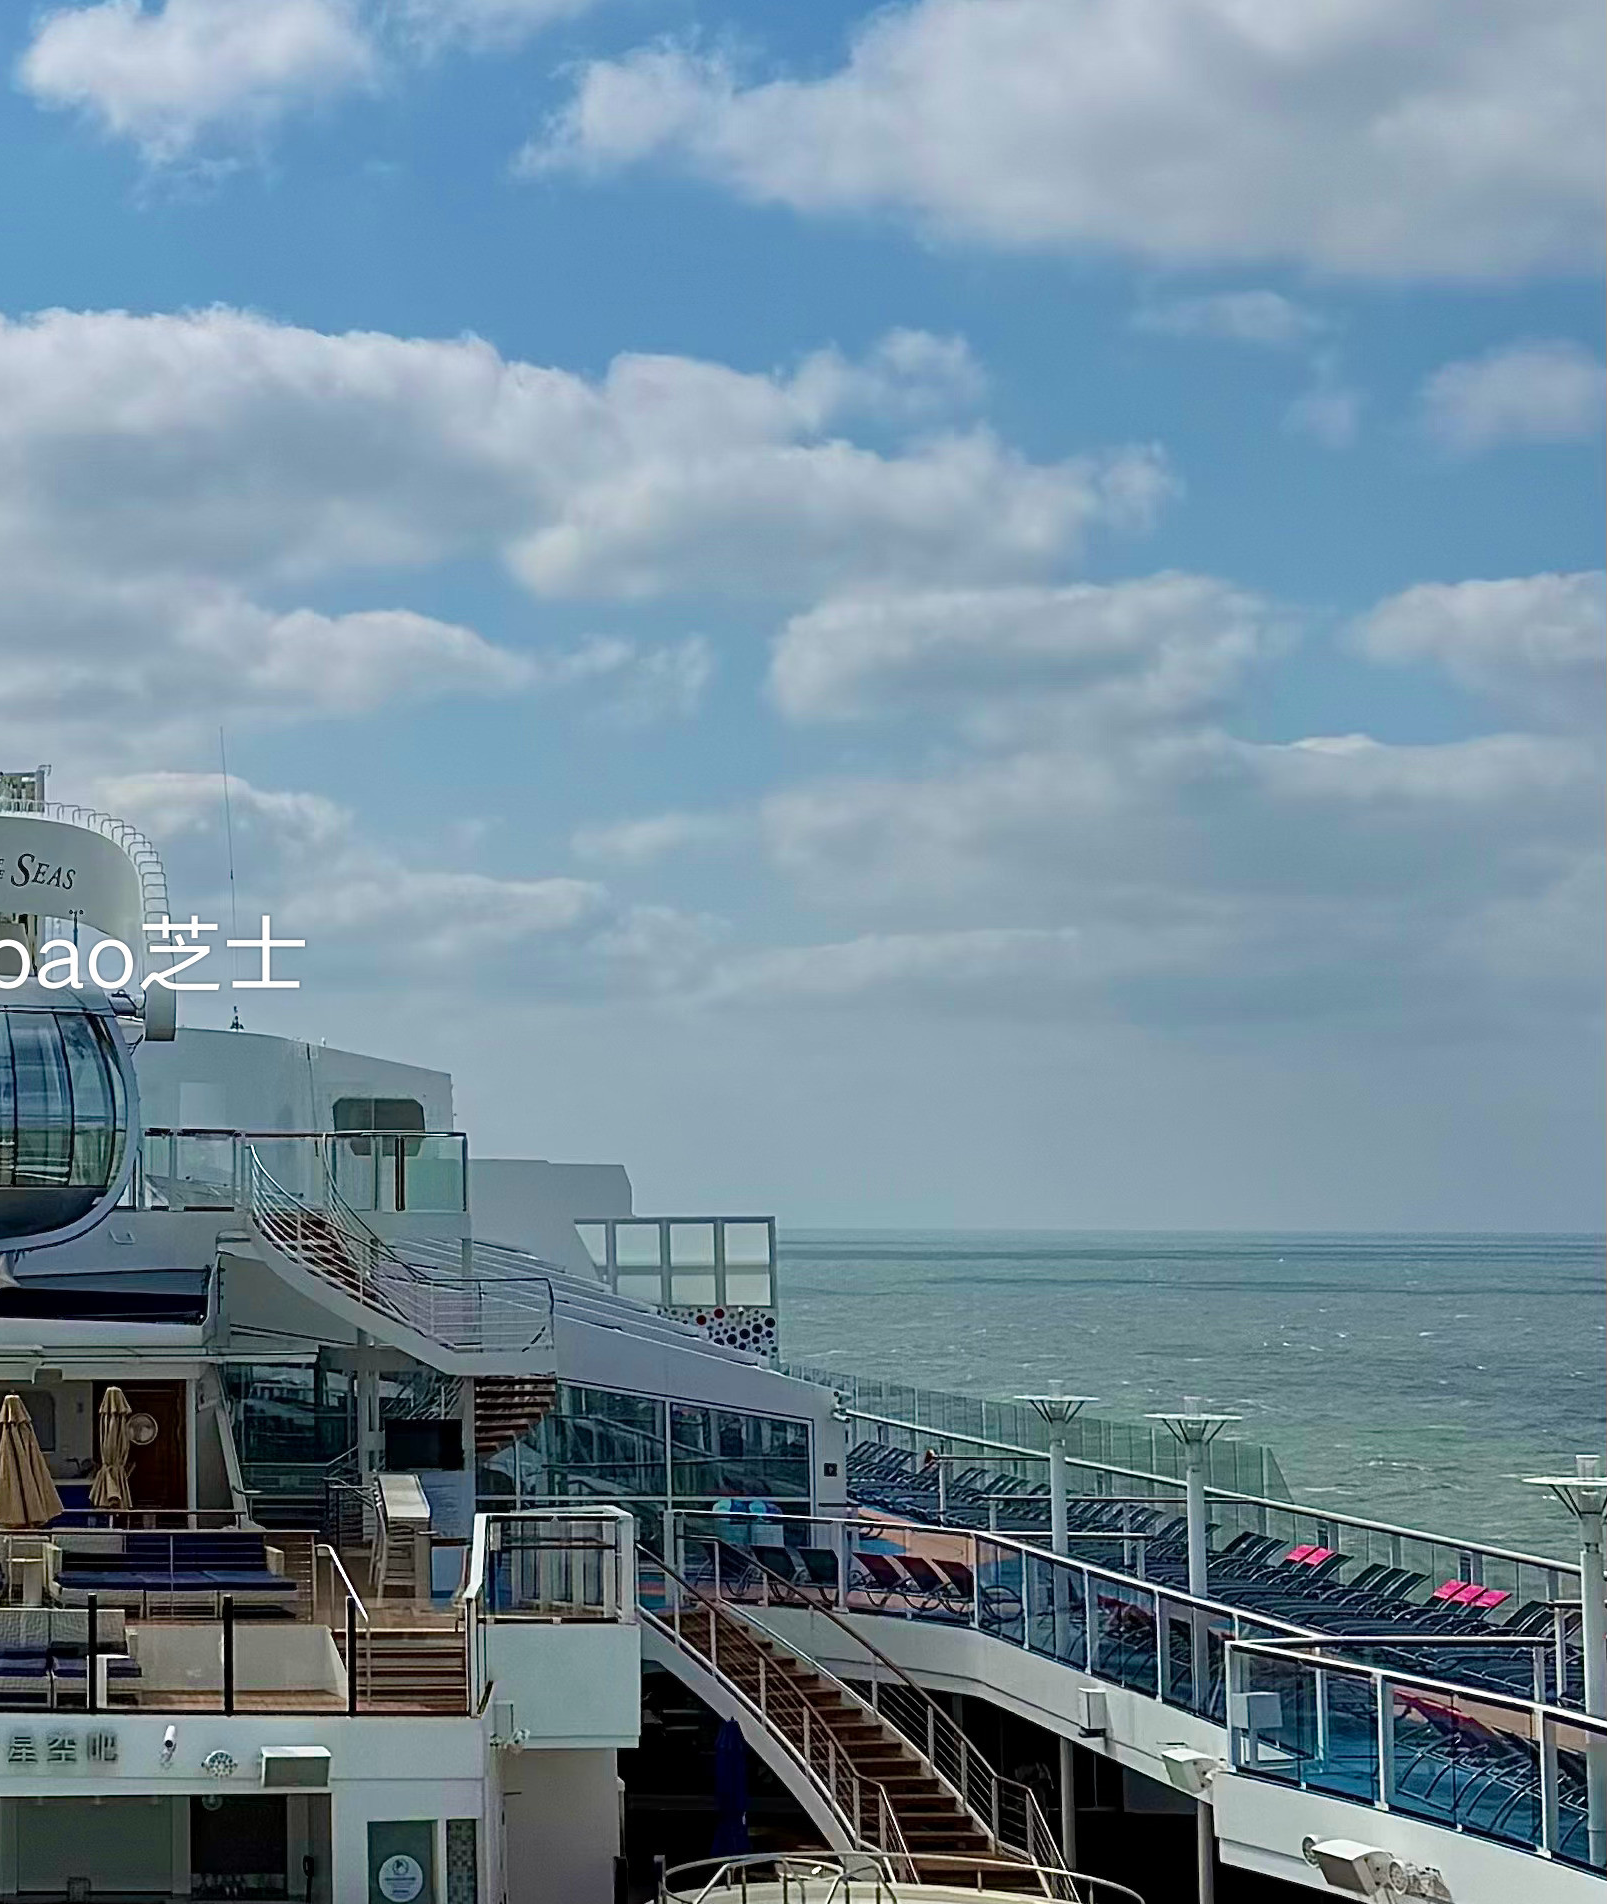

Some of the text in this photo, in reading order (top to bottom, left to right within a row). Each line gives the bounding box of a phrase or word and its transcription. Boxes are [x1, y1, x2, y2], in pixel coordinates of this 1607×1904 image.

[11, 853, 76, 890] SEAS
[8, 1730, 119, 1765] 星空吧
